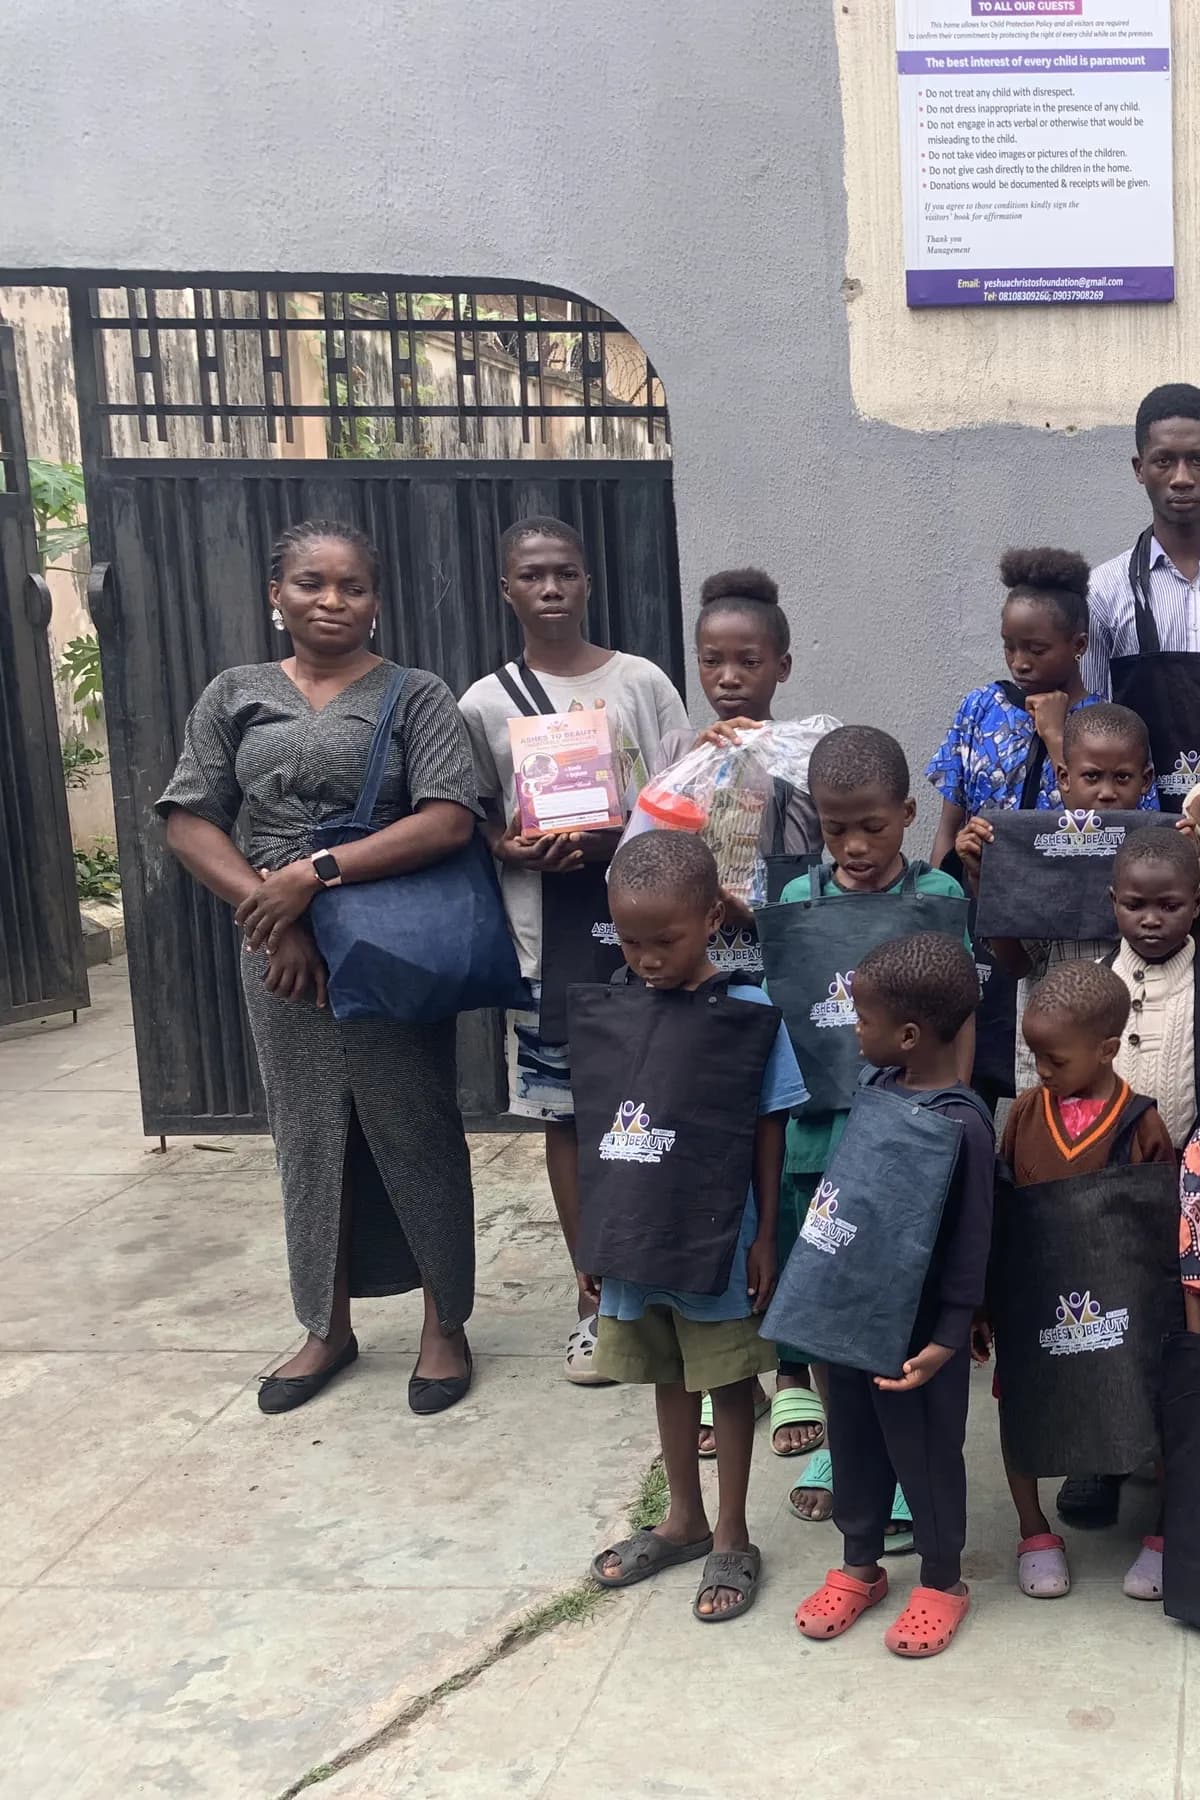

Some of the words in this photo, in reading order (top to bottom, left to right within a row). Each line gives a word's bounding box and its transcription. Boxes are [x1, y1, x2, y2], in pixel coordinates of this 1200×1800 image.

[978, 2, 992, 11] TO
[994, 2, 1012, 11] ALL
[1014, 1, 1035, 11] OUR
[1038, 1, 1075, 10] GUESTS
[1036, 20, 1052, 29] Policy
[1106, 19, 1130, 28] required
[991, 32, 998, 40] by
[999, 32, 1029, 40] protecting
[926, 57, 944, 67] The
[947, 57, 968, 67] best
[970, 57, 1010, 67] interest
[1012, 57, 1022, 66] of
[1024, 59, 1052, 68] every
[1053, 56, 1077, 65] child
[1080, 56, 1088, 65] is
[1090, 55, 1145, 67] paramount
[926, 89, 937, 97] Do
[940, 89, 952, 97] not
[955, 89, 974, 97] treat
[976, 90, 990, 99] any
[992, 88, 1011, 97] child
[1013, 88, 1030, 96] with
[1033, 88, 1075, 98] disrespect.
[926, 105, 937, 113] Do
[940, 105, 953, 113] not
[955, 105, 976, 113] dress
[978, 104, 1031, 114] inappropriate
[1034, 104, 1040, 112] in
[1043, 103, 1055, 112] the
[1058, 105, 1092, 113] presence
[1094, 103, 1102, 111] of
[1104, 105, 1118, 113] any
[1120, 102, 1140, 111] child.
[927, 121, 938, 129] Do
[940, 120, 954, 128] not
[957, 122, 985, 130] engage
[987, 120, 994, 128] in
[996, 119, 1012, 128] acts
[1013, 119, 1038, 127] verbal
[1050, 118, 1088, 127] otherwise
[1090, 118, 1106, 126] that
[1108, 118, 1132, 126] would
[1134, 117, 1144, 126] be
[928, 135, 970, 146] misleading
[972, 135, 980, 143] to
[982, 135, 995, 143] the
[997, 134, 1017, 143] child.
[929, 151, 940, 159] Do
[942, 151, 955, 159] not
[957, 150, 974, 159] take
[976, 150, 997, 158] video
[999, 150, 1026, 160] images
[1038, 149, 1068, 160] pictures
[1070, 149, 1078, 157] of
[1080, 149, 1092, 157] the
[1094, 148, 1127, 157] children.
[929, 166, 940, 175] Do
[943, 166, 956, 174] not
[959, 166, 974, 176] give
[976, 166, 993, 174] cash
[995, 165, 1023, 176] directly
[1026, 165, 1034, 173] to
[1036, 165, 1048, 173] the
[1051, 164, 1081, 173] children
[1084, 164, 1090, 172] in
[1092, 164, 1105, 172] the
[1107, 163, 1132, 172] home.
[930, 181, 969, 189] Donations
[972, 181, 995, 189] would
[999, 180, 1008, 189] be
[1010, 180, 1058, 188] documented
[1061, 179, 1067, 188] &
[1069, 179, 1099, 190] receipts
[1101, 179, 1114, 187] will
[1116, 178, 1125, 187] be
[1128, 178, 1150, 189] given.
[924, 203, 932, 212] If
[1031, 201, 1050, 210] kindly
[1053, 201, 1067, 210] sign
[972, 213, 982, 221] for
[984, 213, 1022, 221] affirmation
[927, 246, 970, 255] Management
[958, 279, 980, 288] Email:
[984, 277, 1123, 289] yeshuachristosfoundation@gmail.com
[984, 292, 997, 300] Tel:
[1053, 291, 1103, 300] 09037908269
[521, 736, 548, 744] ASHES
[564, 730, 597, 738] BEAUTY
[1157, 774, 1182, 785] ASHES
[1034, 833, 1068, 846] ASHES
[1069, 834, 1084, 846] TO
[1086, 833, 1126, 845] BEAUTY
[629, 1135, 675, 1151] BEAUTY
[814, 1217, 856, 1246] BEAUTY
[1040, 1328, 1068, 1343] ASHES
[1069, 1325, 1084, 1340] TO
[1085, 1316, 1129, 1335] BEAUTY
